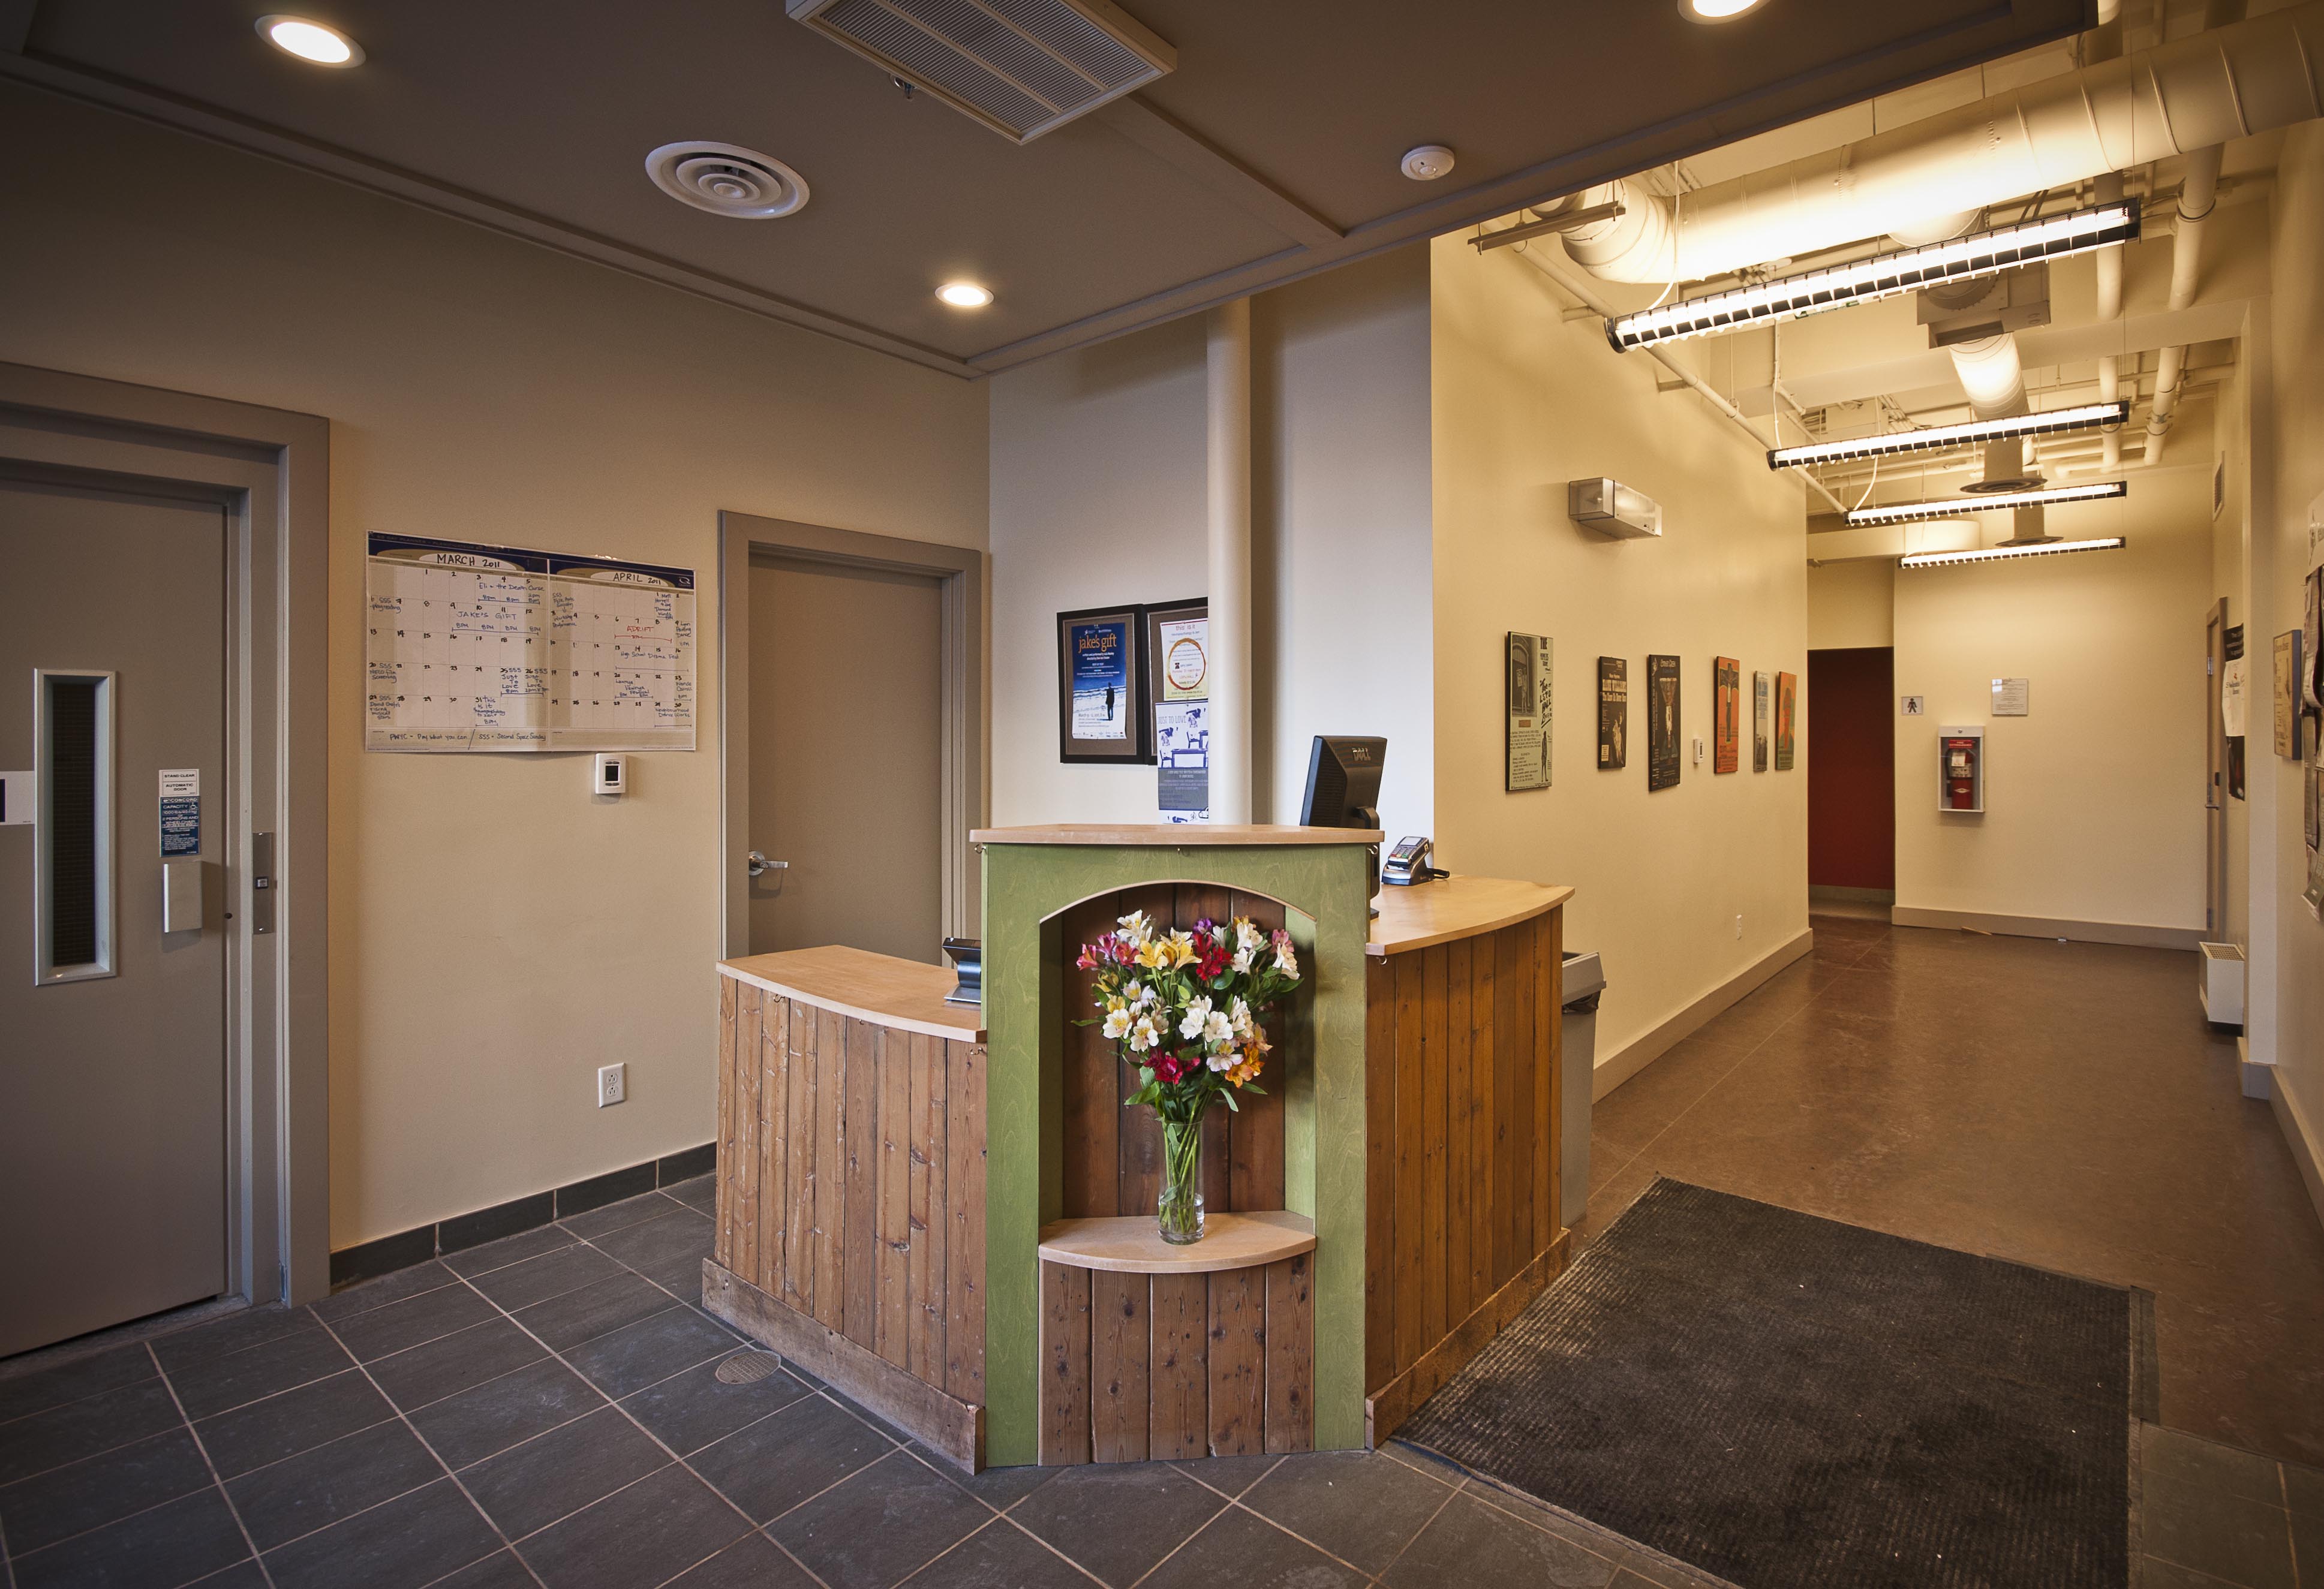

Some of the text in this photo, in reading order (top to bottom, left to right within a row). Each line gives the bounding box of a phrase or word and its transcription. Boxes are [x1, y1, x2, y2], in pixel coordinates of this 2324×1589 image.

[437, 553, 500, 568] MARCH 2011
[613, 572, 643, 582] APRIL
[1078, 633, 1117, 654] jake's gift
[1158, 715, 1186, 724] JUST TO LOVE
[530, 732, 546, 741] Sunday
